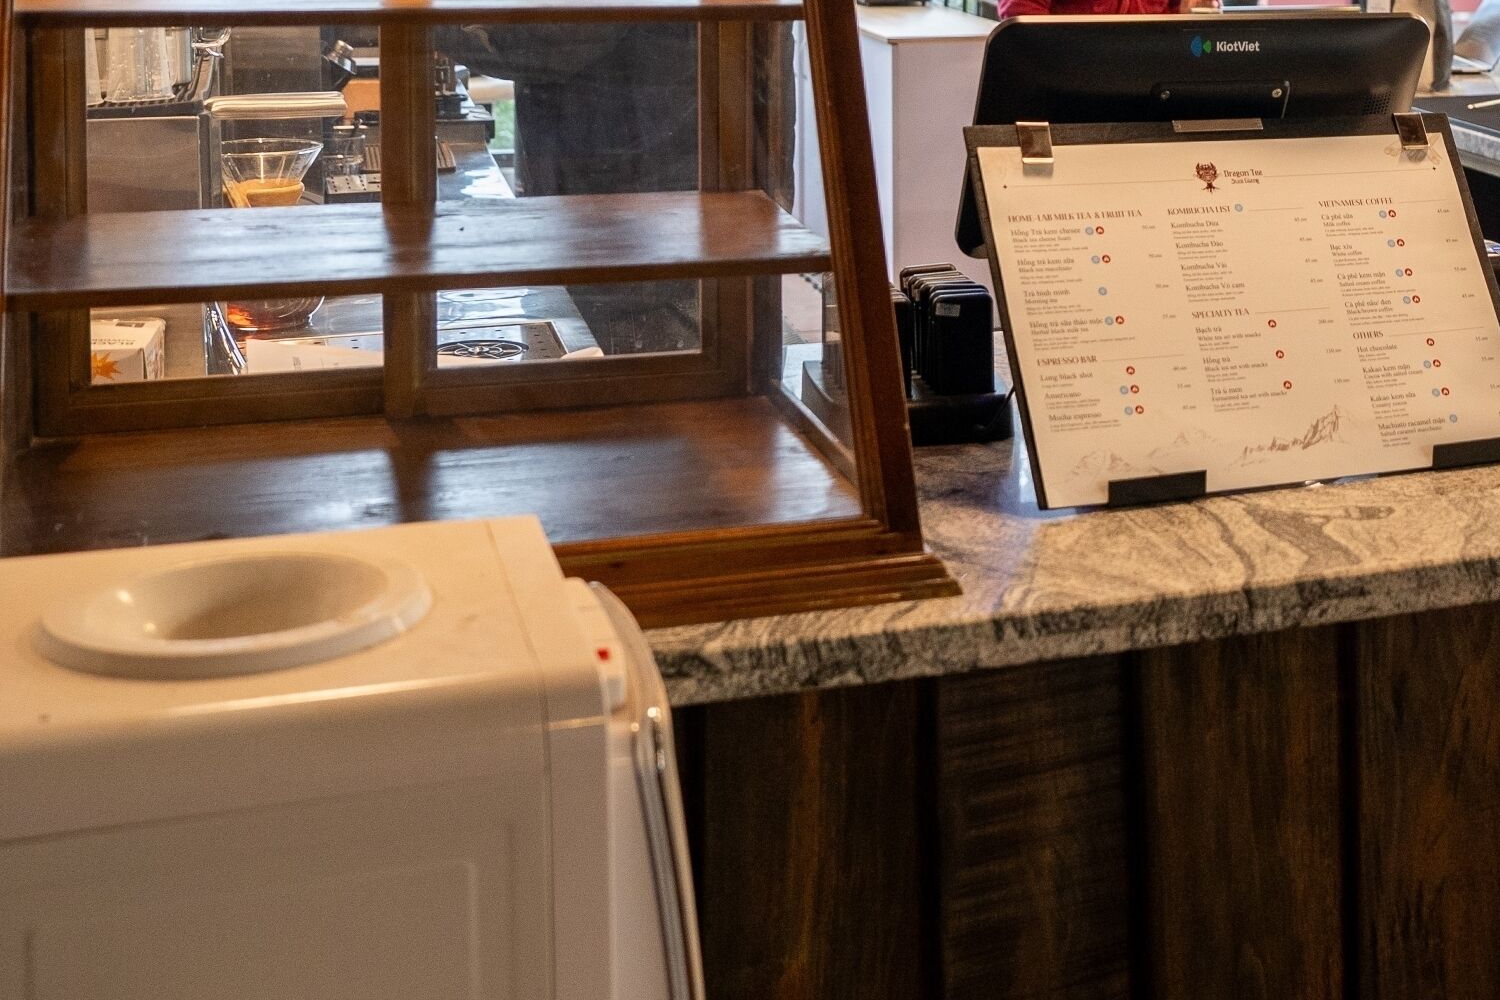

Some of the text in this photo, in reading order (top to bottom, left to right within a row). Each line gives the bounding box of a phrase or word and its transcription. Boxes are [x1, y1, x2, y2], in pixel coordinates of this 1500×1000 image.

[1216, 40, 1260, 52] KiotViet
[1318, 197, 1393, 208] VIETNAMESE COFFEE
[1054, 213, 1074, 221] MILK
[1077, 212, 1092, 220] TEA
[1102, 210, 1125, 219] FRUIT
[1127, 209, 1142, 217] TEA
[1167, 206, 1215, 216] KOMBUCHA
[1170, 221, 1204, 229] Kombucha
[1175, 241, 1209, 249] Kombucha
[1180, 263, 1214, 271] Kombucha
[1186, 284, 1220, 292] Kombucha
[1192, 308, 1250, 319] SPECIALTY TEA
[1352, 331, 1384, 340] OTHERS
[1369, 344, 1398, 352] chocolate
[1037, 355, 1098, 366] ESPRESSO BAR
